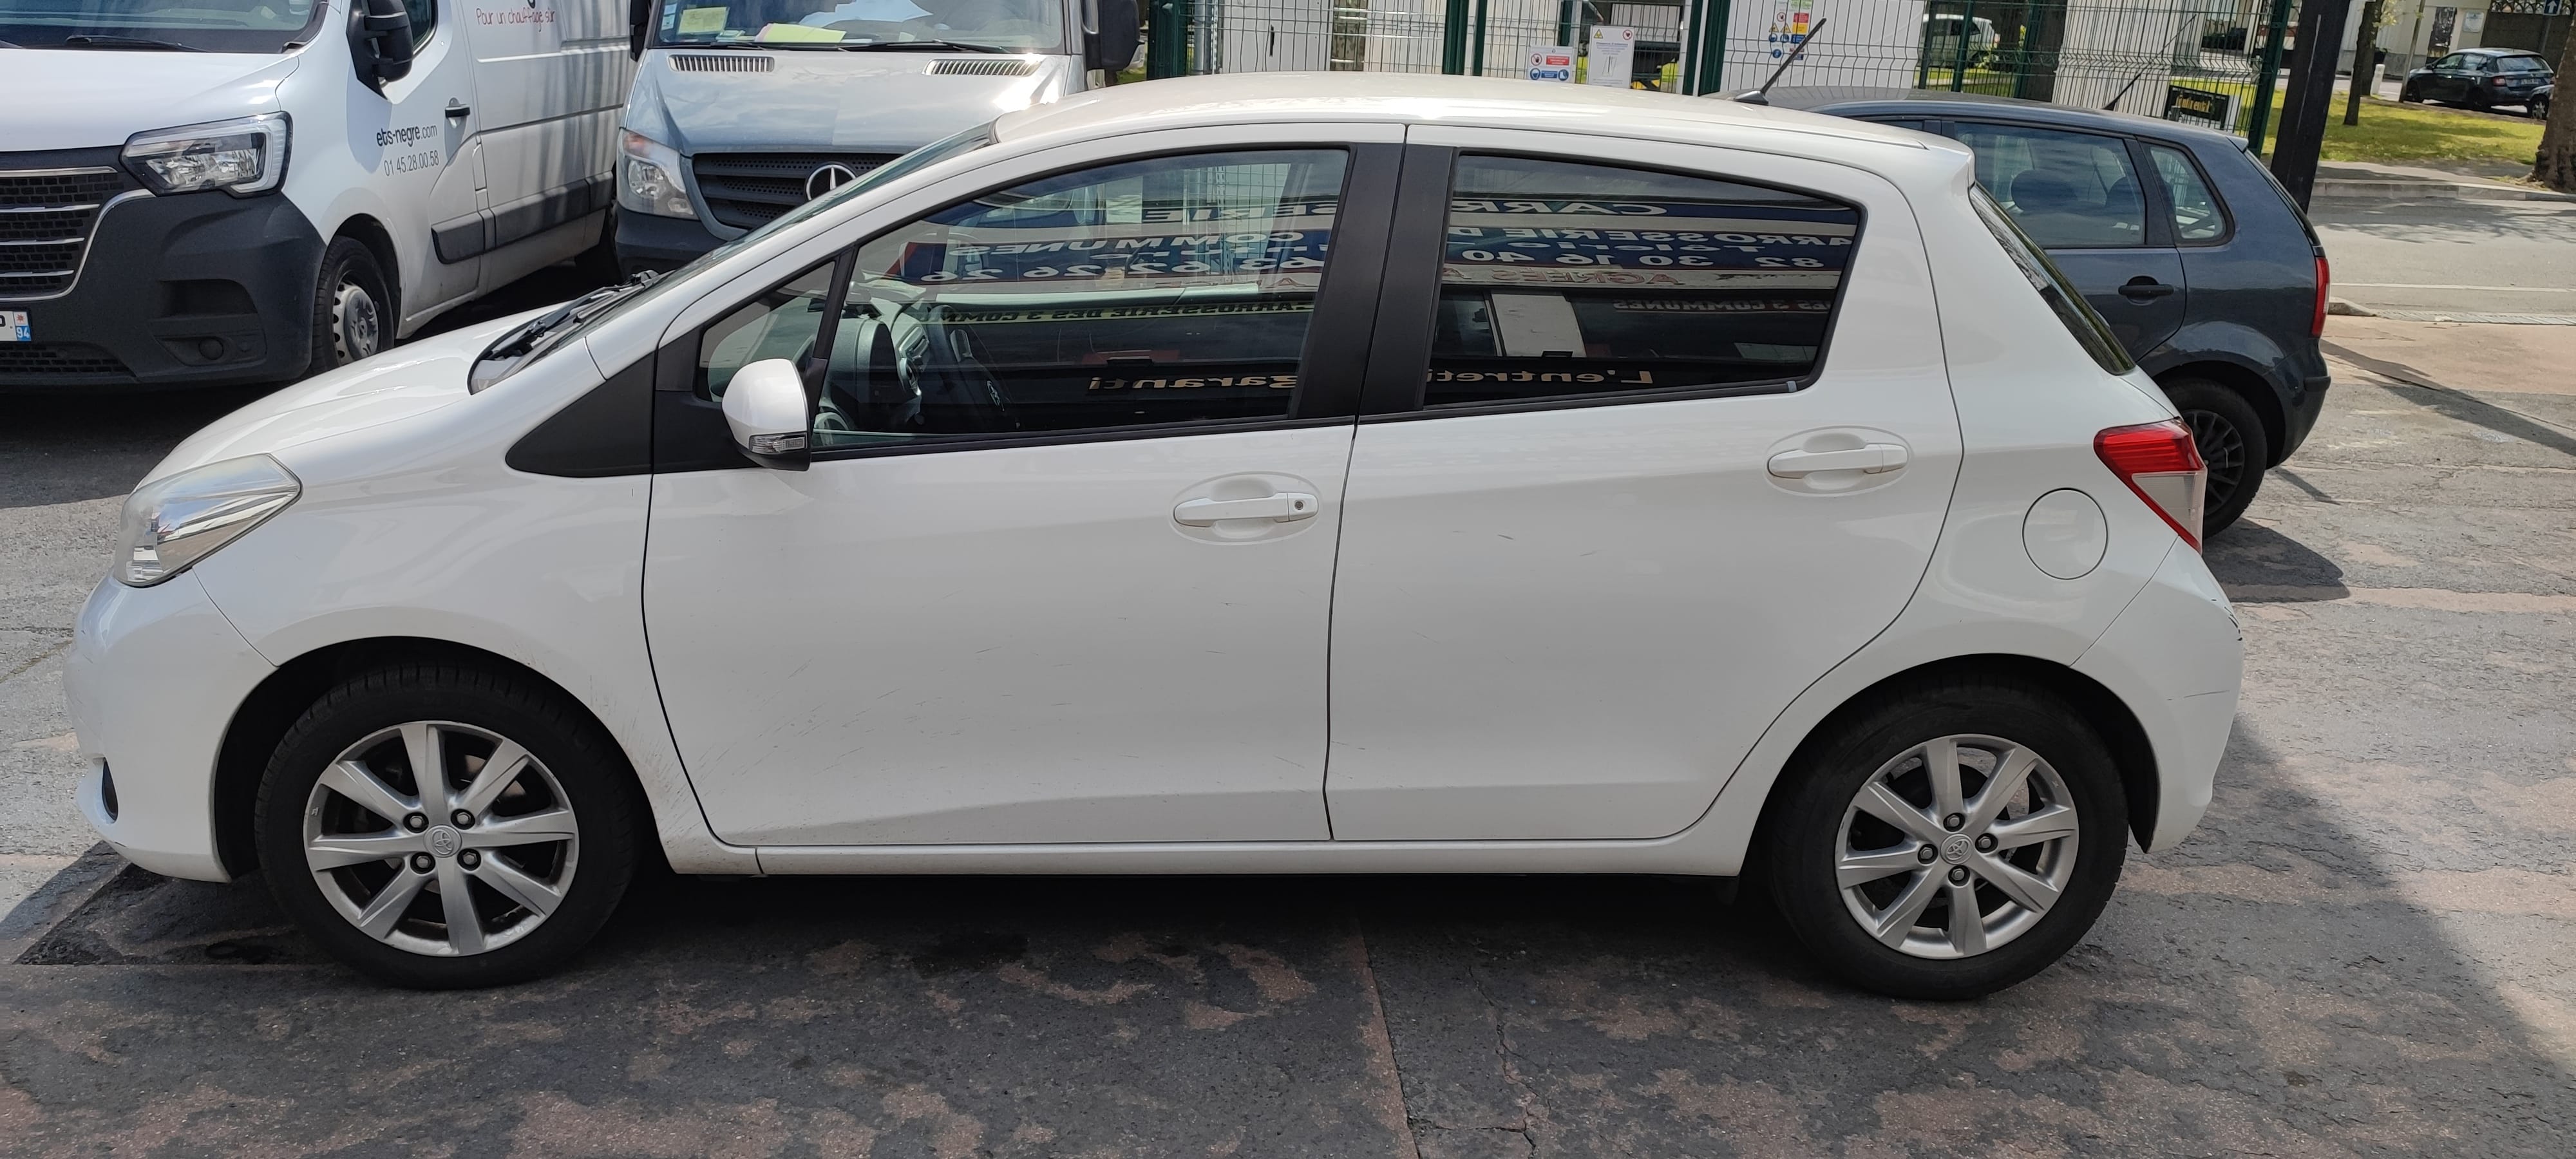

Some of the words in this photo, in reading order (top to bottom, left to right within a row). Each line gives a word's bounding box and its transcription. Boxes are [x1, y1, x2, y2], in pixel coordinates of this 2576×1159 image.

[476, 8, 495, 25] Pour
[497, 12, 506, 24] un
[507, 7, 544, 32] chauffage
[376, 124, 438, 147] ets-negre.com
[384, 158, 395, 177] 01
[396, 149, 439, 173] 45.28.00.58
[16, 326, 30, 339] 94
